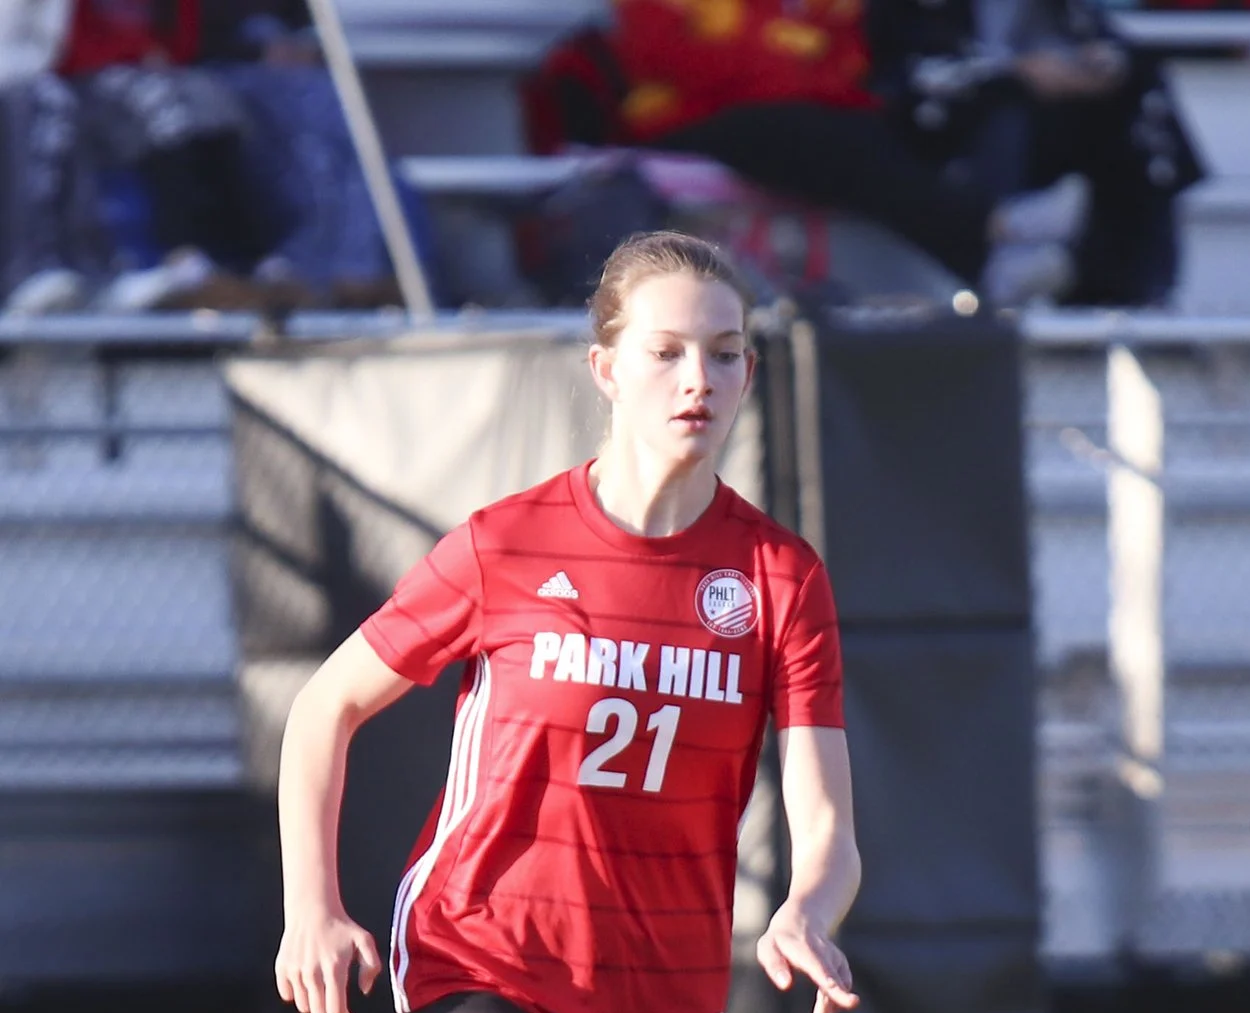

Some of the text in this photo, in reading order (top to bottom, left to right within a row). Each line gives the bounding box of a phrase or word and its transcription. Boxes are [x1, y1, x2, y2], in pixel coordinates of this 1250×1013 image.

[537, 587, 579, 600] adidas
[709, 586, 736, 601] PHLT
[529, 631, 743, 705] PARK HILL
[577, 697, 682, 793] 21
